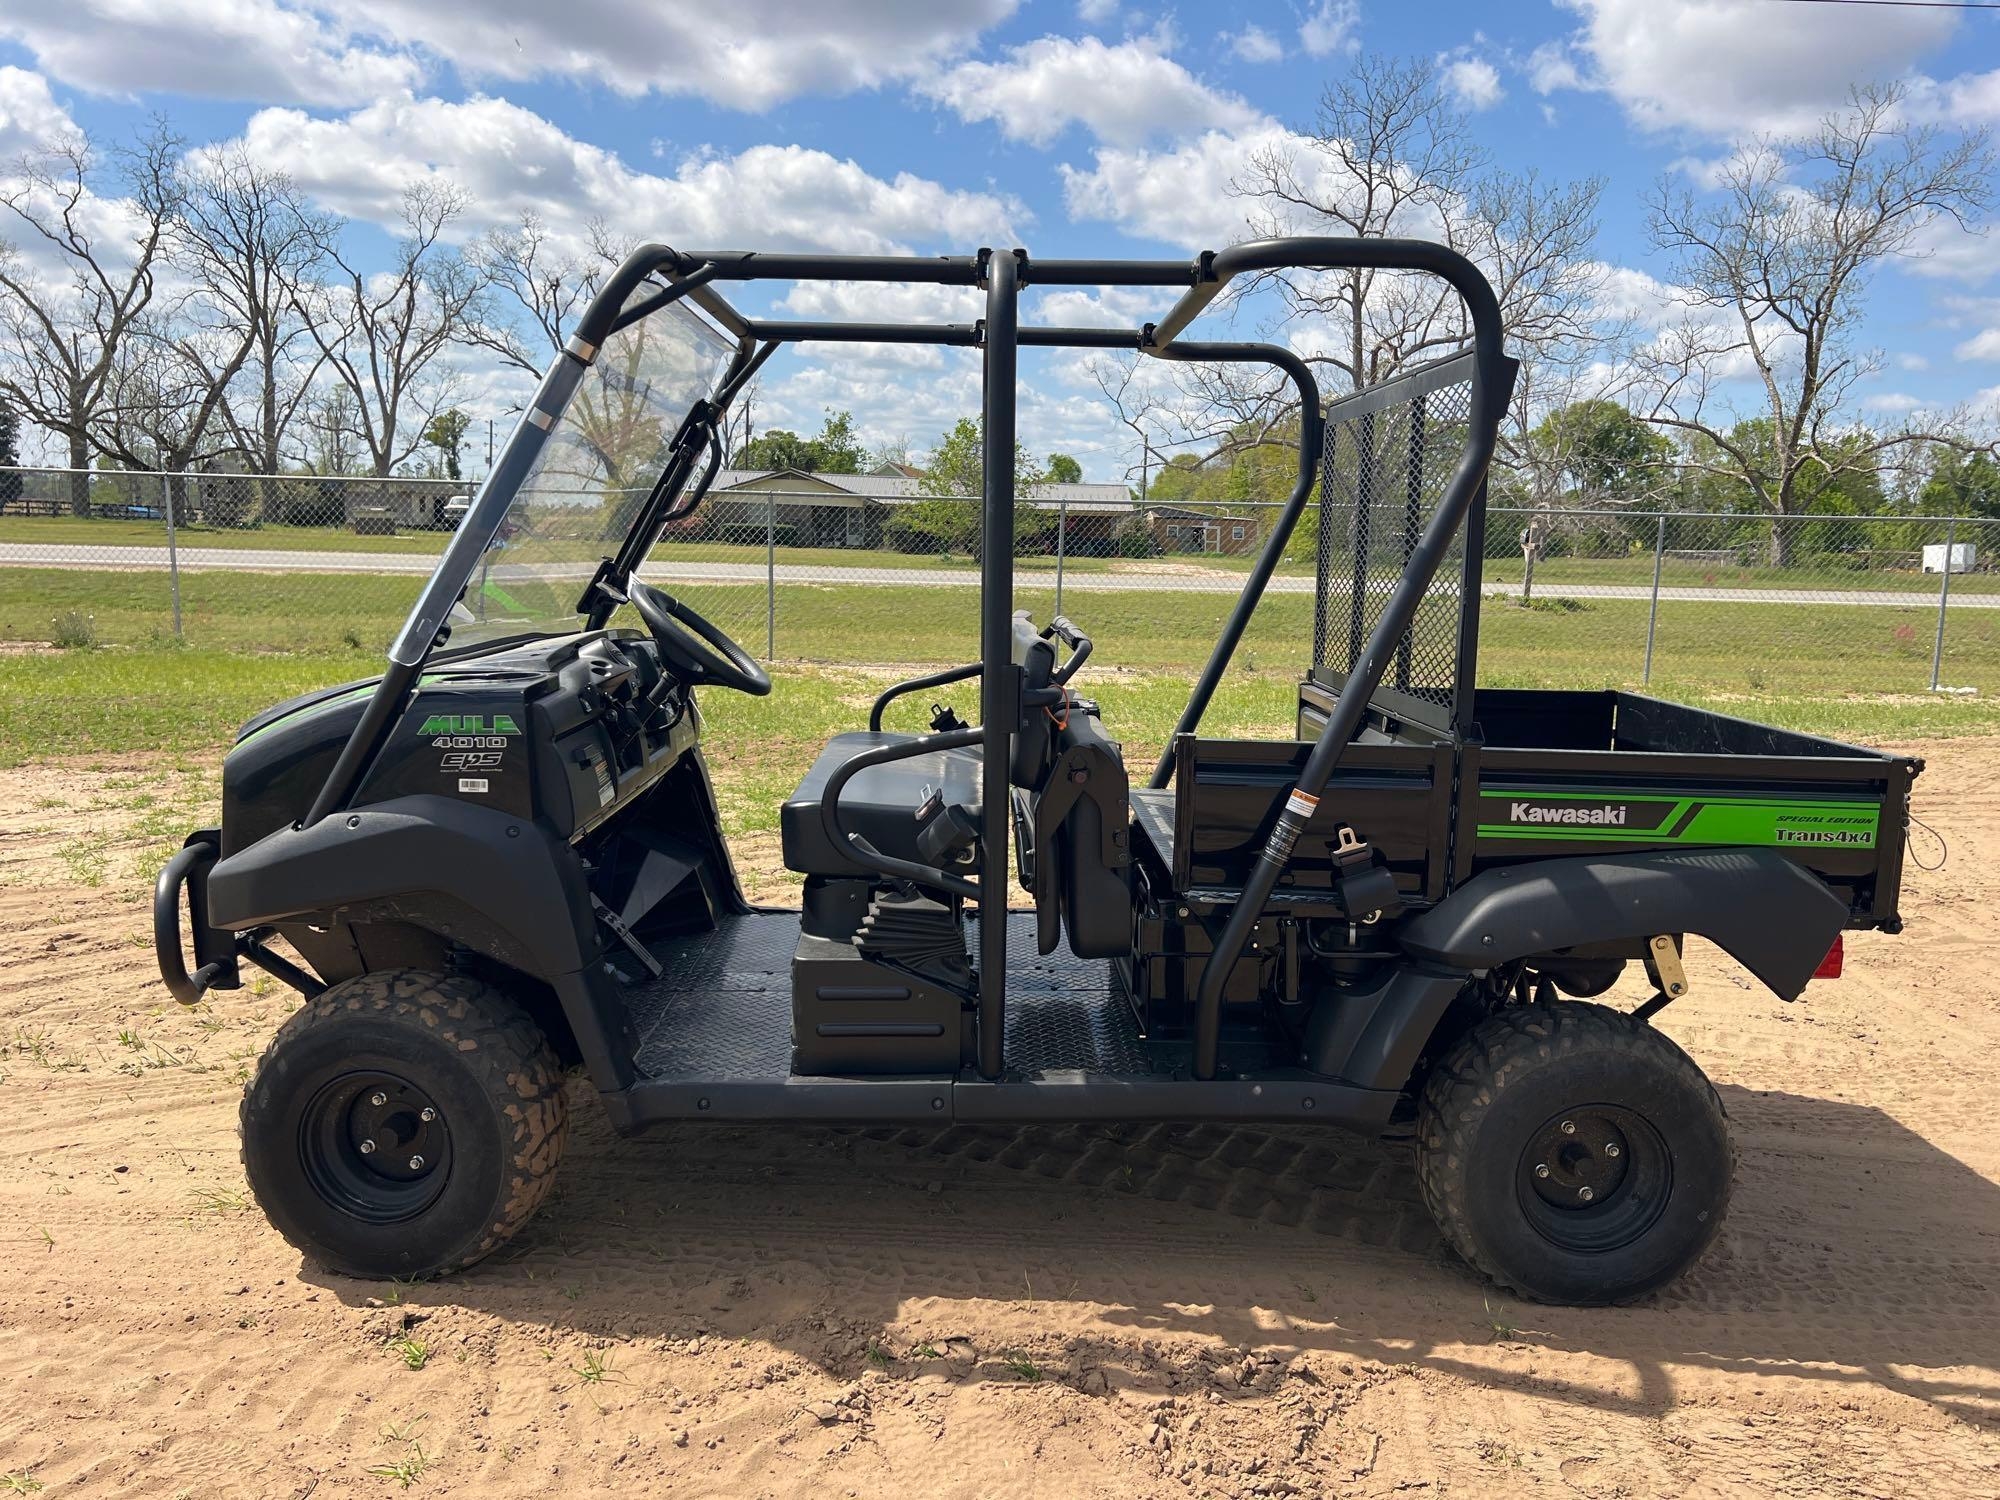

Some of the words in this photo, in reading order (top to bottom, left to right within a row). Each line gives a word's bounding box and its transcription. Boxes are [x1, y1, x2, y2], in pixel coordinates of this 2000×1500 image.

[417, 715, 521, 735] MULE
[432, 737, 507, 748] 4010
[1510, 803, 1626, 824] Kawasaki
[1776, 815, 1824, 823] SPECIAL
[1776, 829, 1873, 843] Trans4x4
